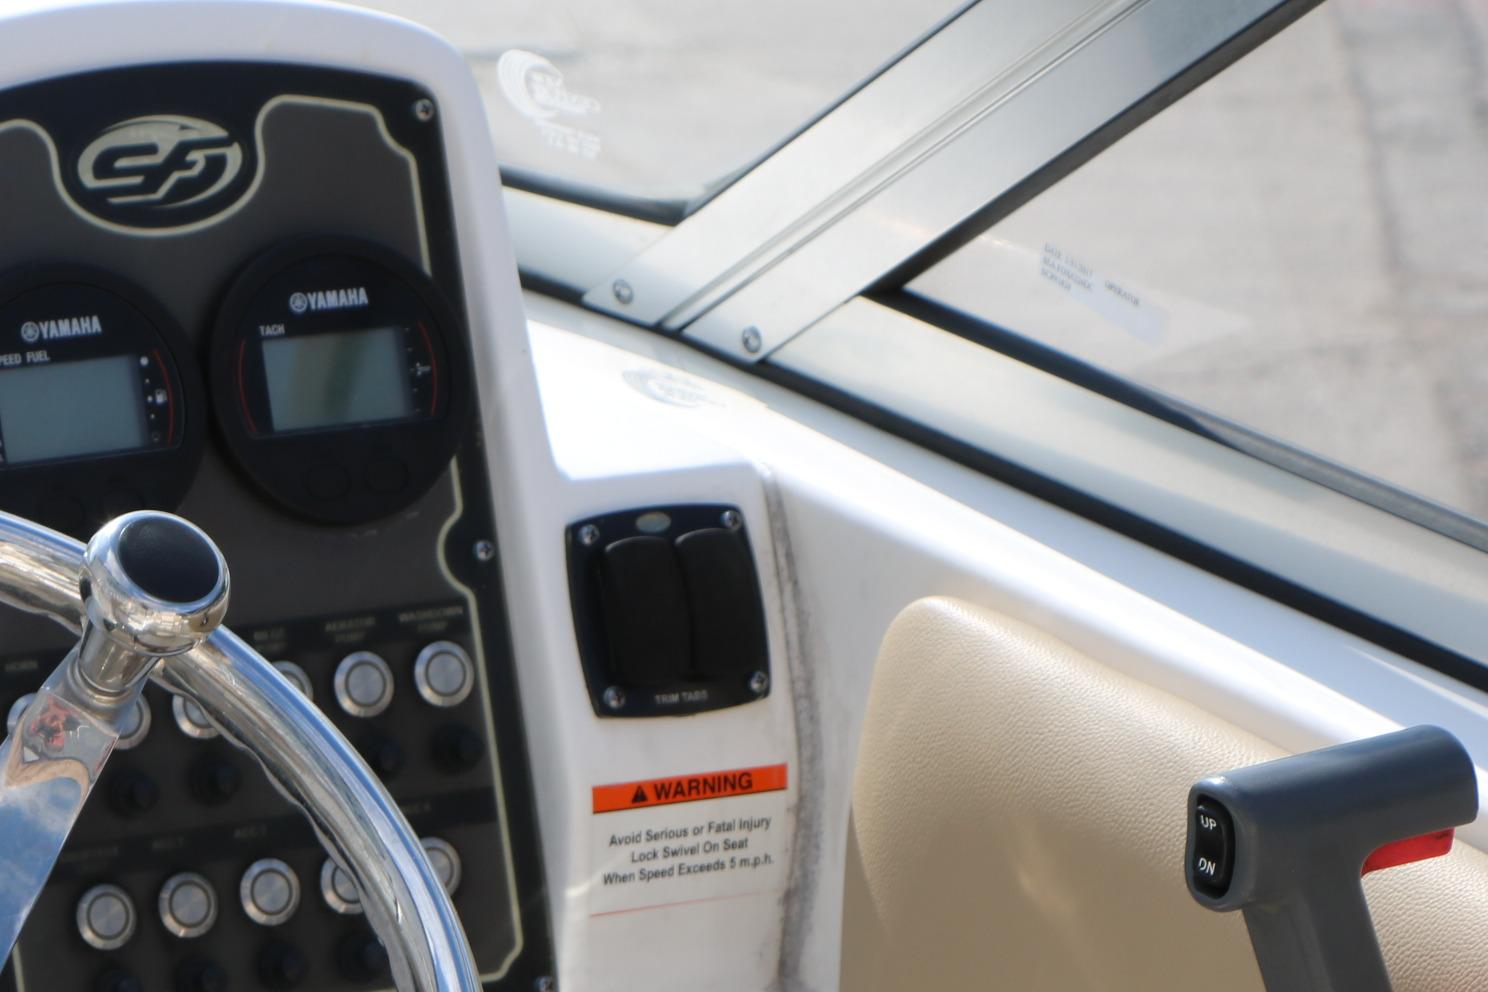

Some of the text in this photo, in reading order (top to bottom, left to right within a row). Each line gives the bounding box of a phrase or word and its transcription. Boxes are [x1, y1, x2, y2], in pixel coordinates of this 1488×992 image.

[307, 287, 368, 311] YAMAHA
[40, 315, 102, 340] YAMAHA
[259, 324, 285, 336] TACH
[26, 350, 50, 364] FUEL
[654, 772, 752, 801] WARNING
[609, 816, 772, 847] Avoid Serious or Fatal Injury
[1200, 814, 1217, 830] UP
[631, 837, 748, 863] Lock Swivel On Seat
[603, 852, 774, 885] When Speed Exceeds 5 m.p.h.
[1198, 857, 1216, 876] DN
